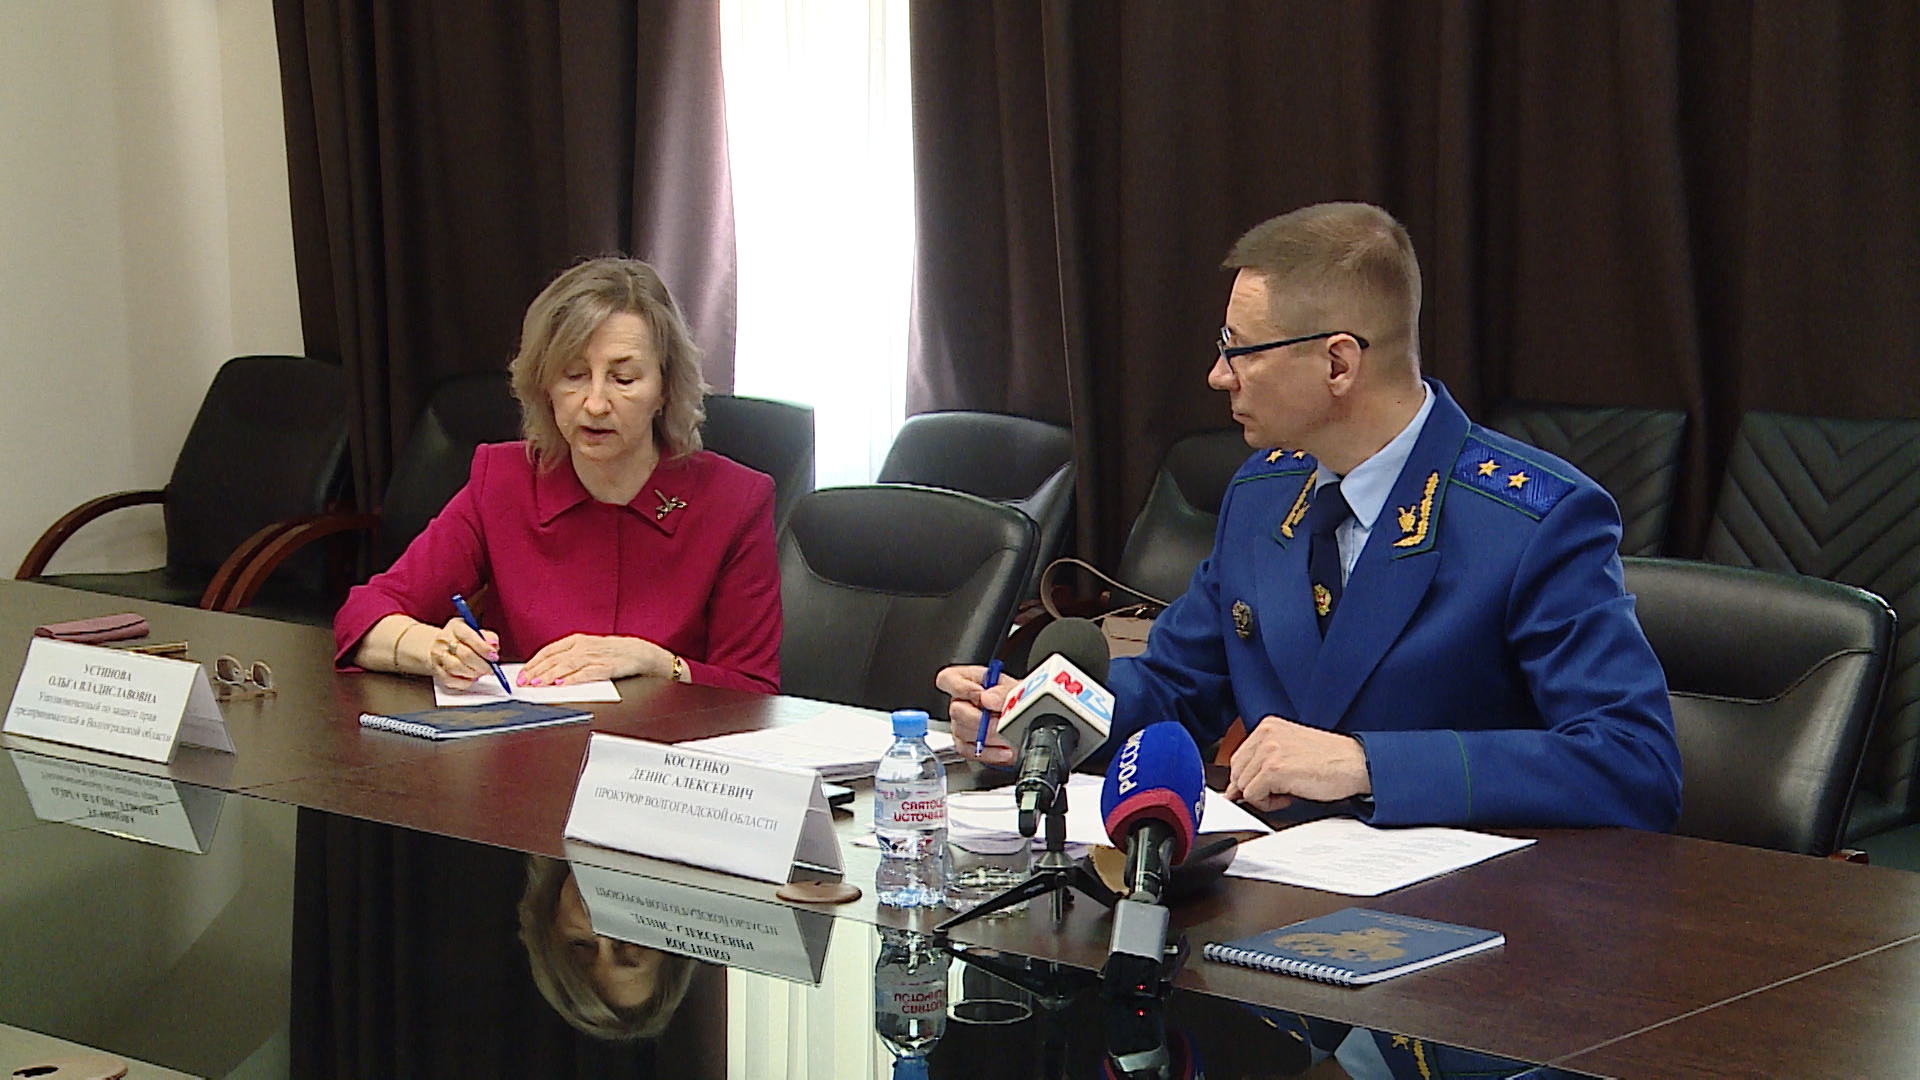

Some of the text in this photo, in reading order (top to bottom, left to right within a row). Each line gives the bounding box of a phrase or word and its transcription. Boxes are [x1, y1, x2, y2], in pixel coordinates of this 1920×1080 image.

[83, 663, 132, 682] УСТИНОВА
[48, 675, 157, 704] ОЛЬГА ВЛАДИСЛАВОВНА
[664, 753, 730, 776] КОСТЕНКО
[628, 767, 754, 800] ДЕНИС АЛЕКСЕЕВИЧ
[594, 787, 778, 832] ПРОКУРОР ВОЛГОГРАДСКОЙ ОБЛАСТИ
